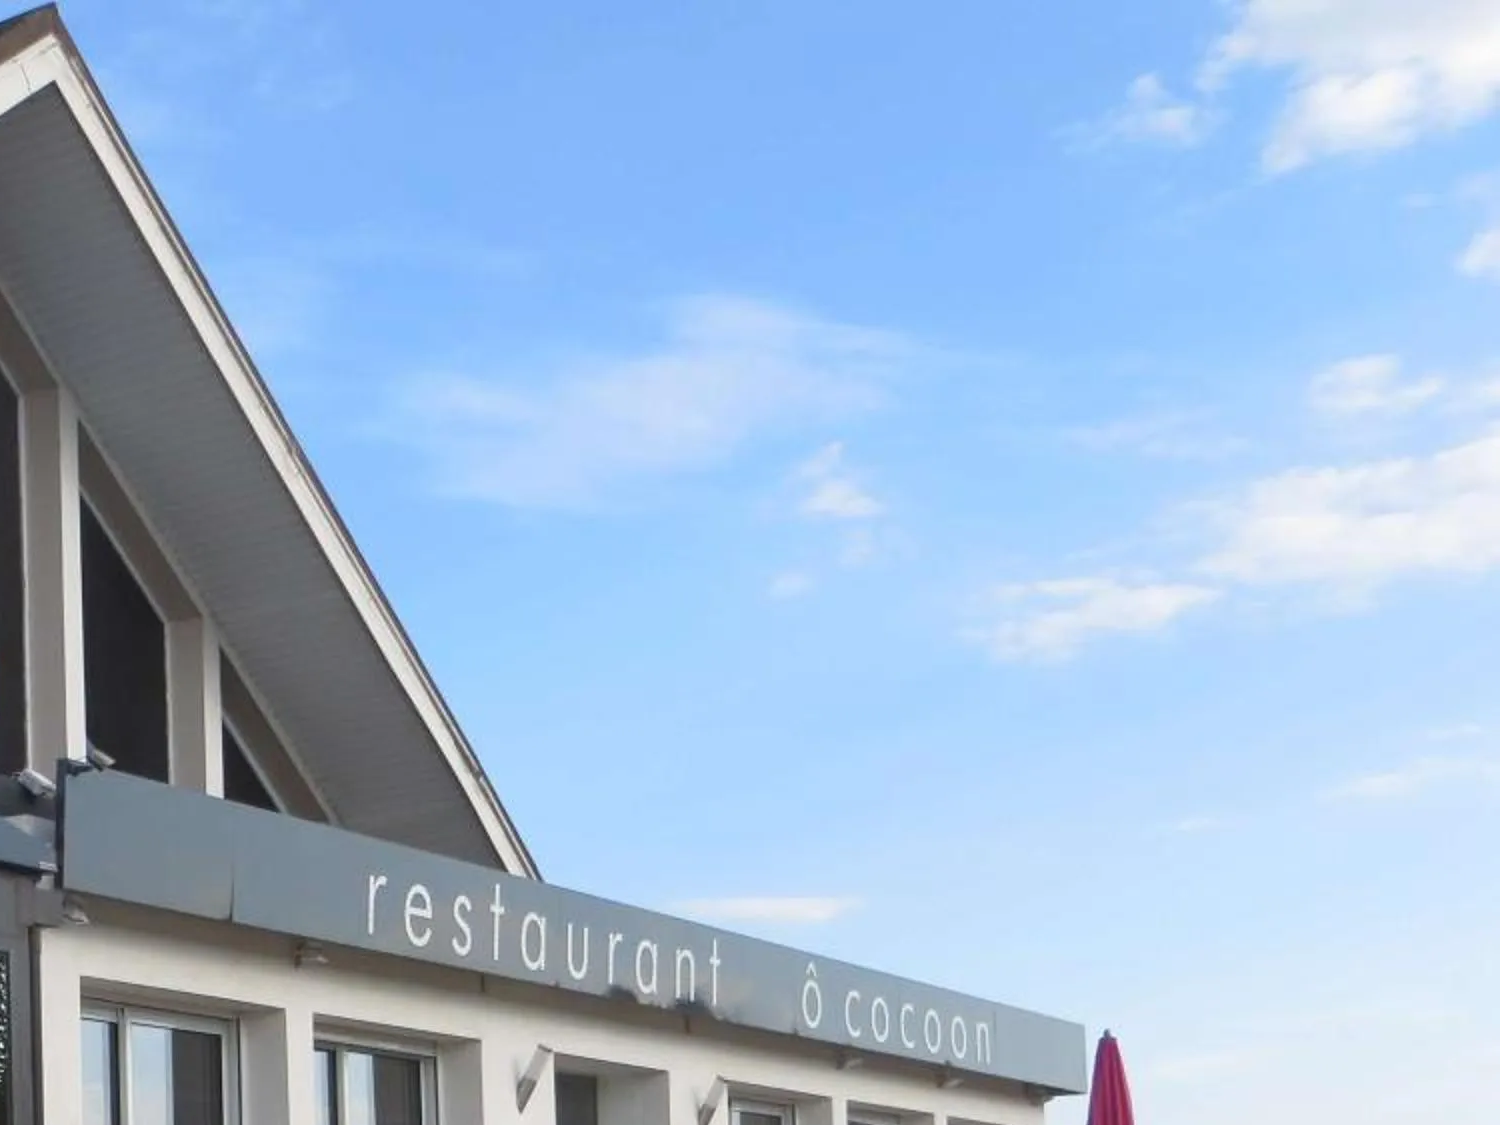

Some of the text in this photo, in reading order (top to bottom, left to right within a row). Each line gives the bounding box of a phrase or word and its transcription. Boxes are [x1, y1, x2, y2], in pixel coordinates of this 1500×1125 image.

[366, 869, 991, 1065] restaurant ô cocoon
